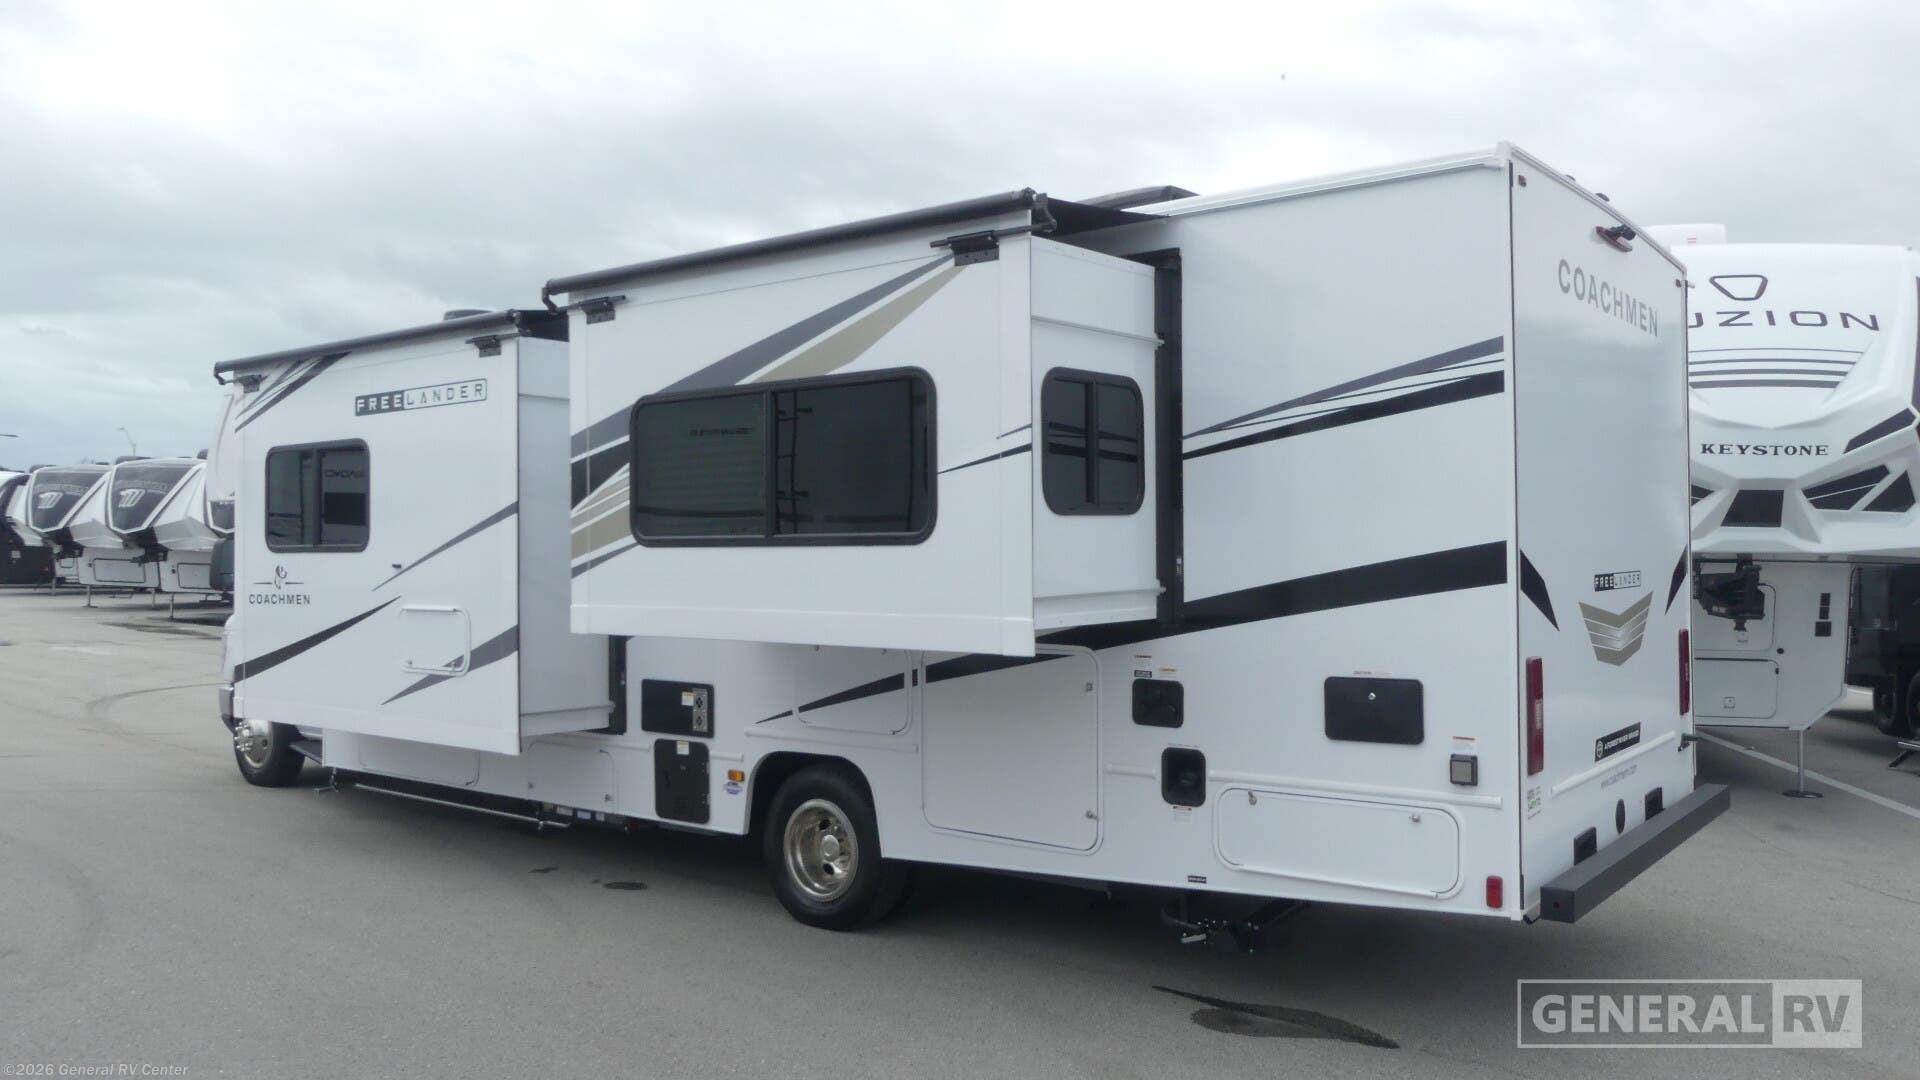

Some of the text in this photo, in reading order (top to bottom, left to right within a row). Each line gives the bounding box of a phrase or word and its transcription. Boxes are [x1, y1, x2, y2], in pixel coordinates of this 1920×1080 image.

[1558, 258, 1659, 338] COACHMEN
[355, 382, 485, 413] FREELANDER
[1700, 443, 1829, 457] KEYSTONE
[248, 593, 311, 606] COACHMEN
